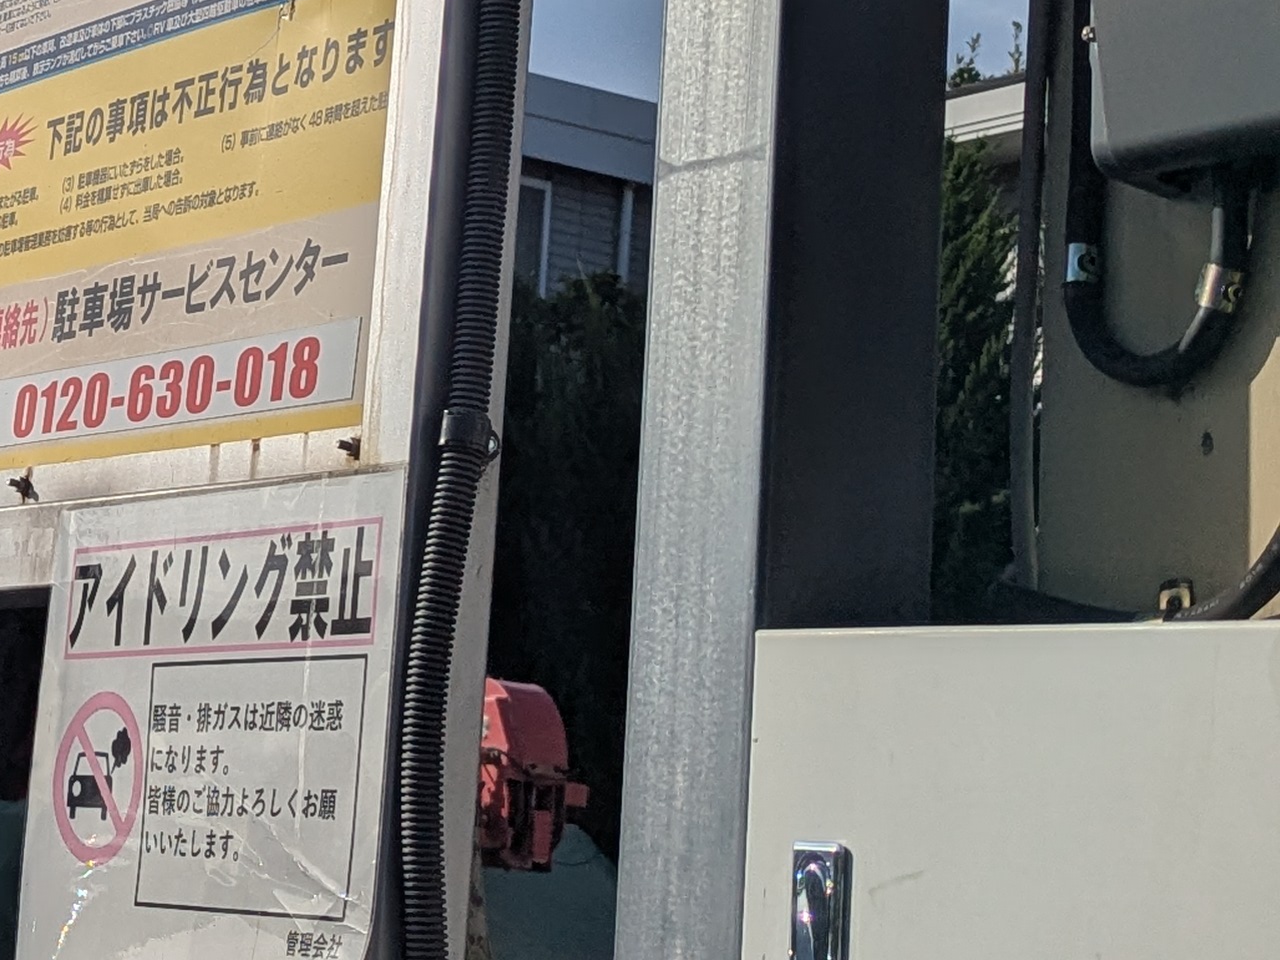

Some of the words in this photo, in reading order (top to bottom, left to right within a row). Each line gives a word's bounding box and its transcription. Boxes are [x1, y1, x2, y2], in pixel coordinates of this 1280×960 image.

[46, 18, 394, 161] 下記の事項は不正行為となります
[51, 238, 349, 344] 駐車場サービスセンター
[12, 336, 321, 438] 0120-630-018
[70, 526, 375, 648] アイドリング禁止
[152, 700, 344, 734] 騒音・排ガスは近隣の迷惑
[150, 745, 230, 776] になります。
[147, 787, 338, 822] 皆様のご協力よろしくお願
[144, 830, 240, 862] いいたします。
[286, 929, 343, 959] 管理会社
